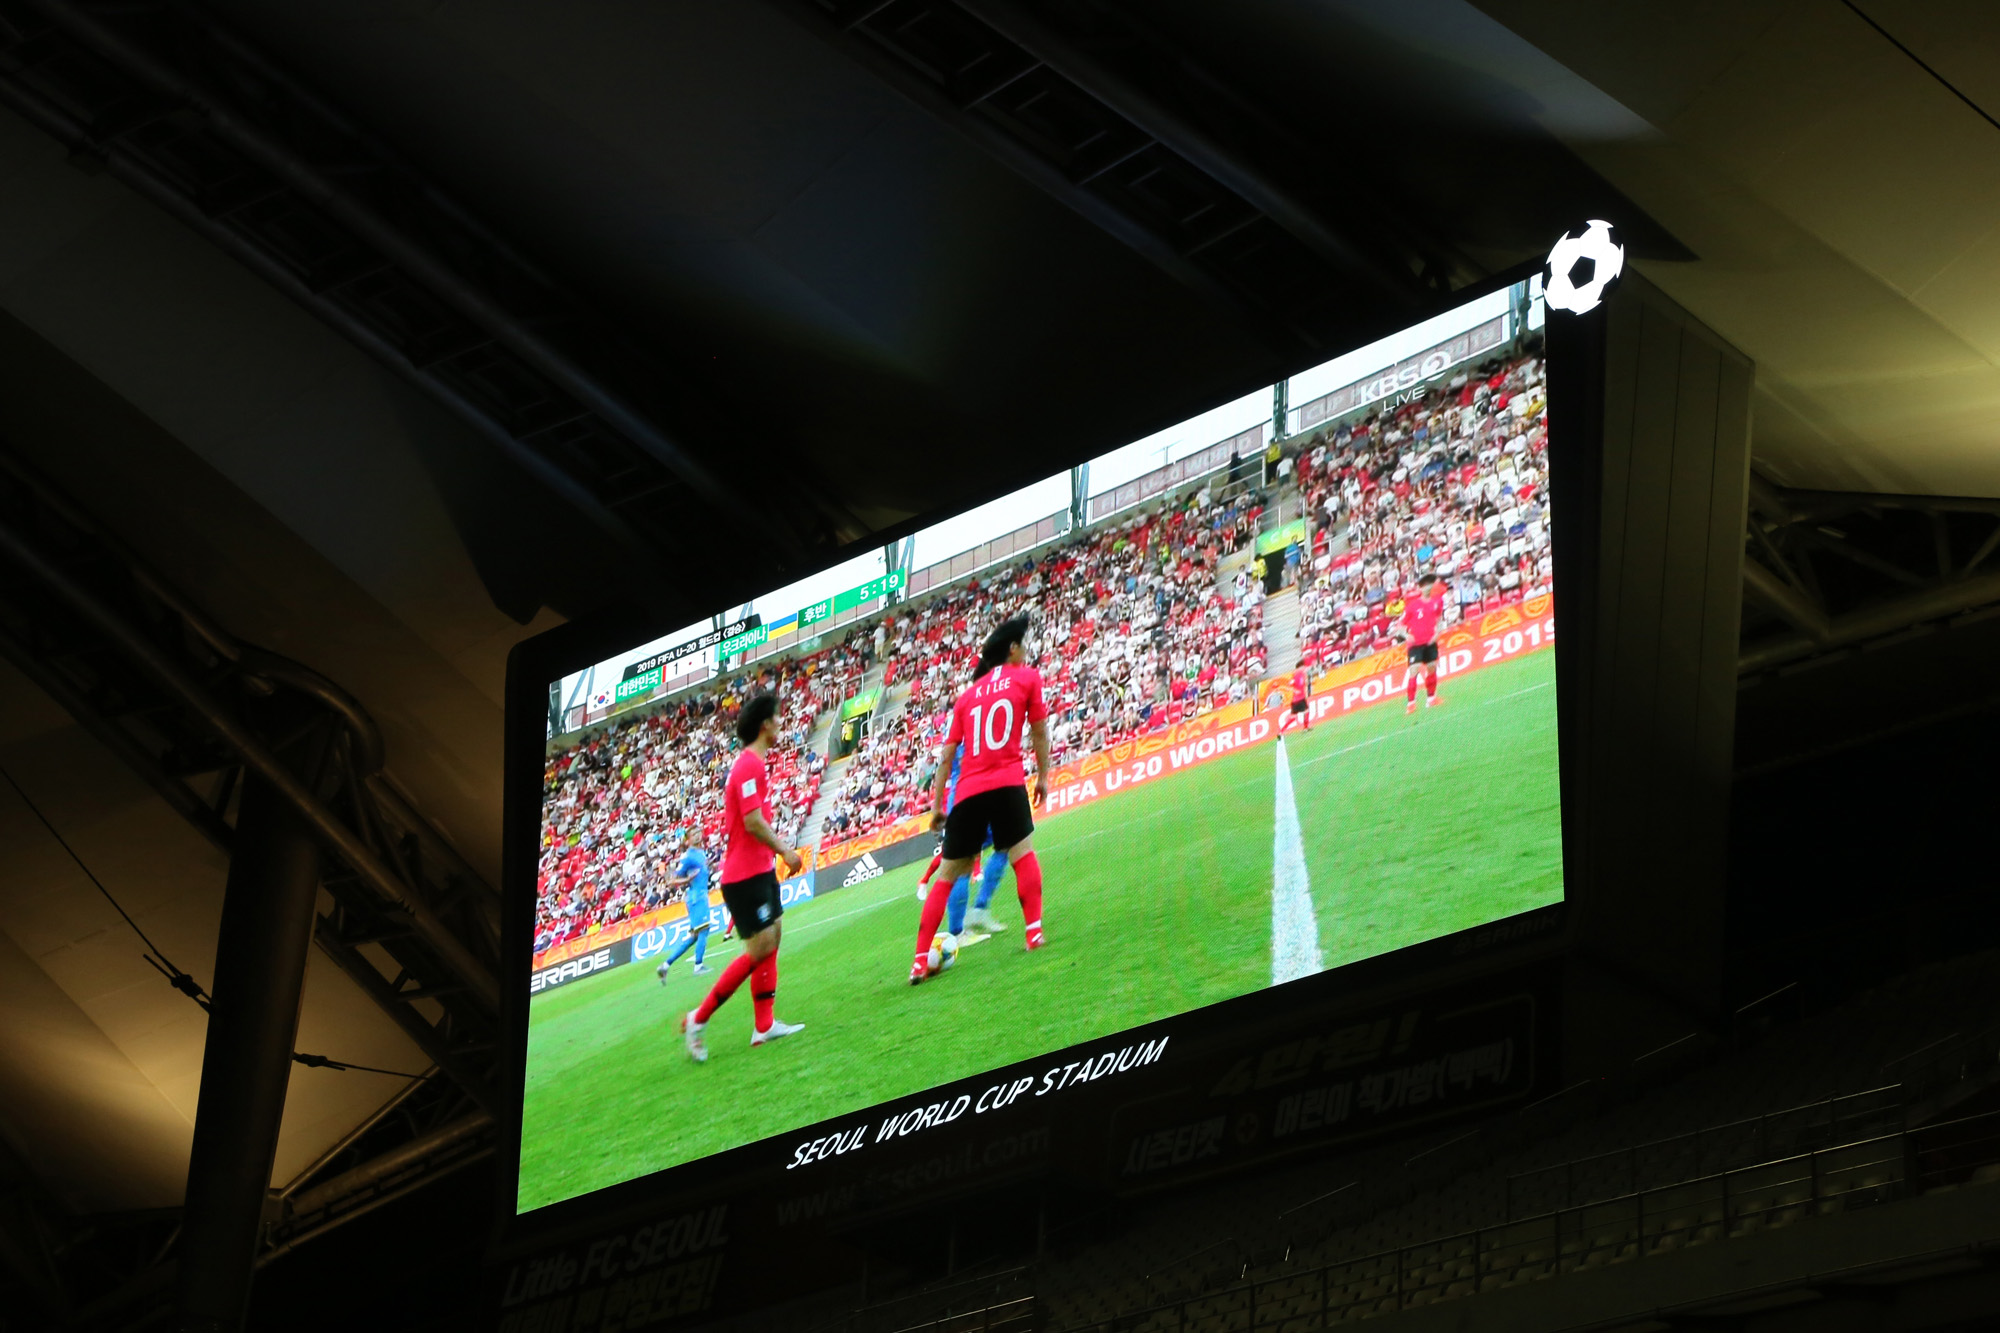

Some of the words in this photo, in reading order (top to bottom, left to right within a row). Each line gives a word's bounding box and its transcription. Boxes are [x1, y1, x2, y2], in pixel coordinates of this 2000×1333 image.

[1383, 385, 1426, 413] LIVE
[860, 574, 899, 600] 5:19
[804, 602, 827, 623] 후반
[637, 658, 656, 674] 2019
[657, 651, 676, 667] FIFA
[676, 642, 697, 658] U-20
[698, 632, 721, 649] 월드컵
[722, 629, 767, 657] 우크라이나
[617, 669, 660, 698] 대한민국
[970, 698, 1013, 757] 10
[1046, 778, 1098, 813] FIFA
[1105, 755, 1162, 792] U-20
[1170, 718, 1270, 770] WORLD
[842, 865, 884, 889] adidas
[785, 1124, 869, 1171] SEOUL
[873, 1094, 972, 1144] WORLD
[974, 1075, 1034, 1115] CUP
[1034, 1035, 1171, 1097] STADIUM
[1120, 1114, 1227, 1176] 시즌티켓
[1273, 1081, 1354, 1139] 어린이
[501, 1252, 578, 1309] Little
[579, 1235, 628, 1286] FC
[624, 1203, 729, 1272] SEOUL
